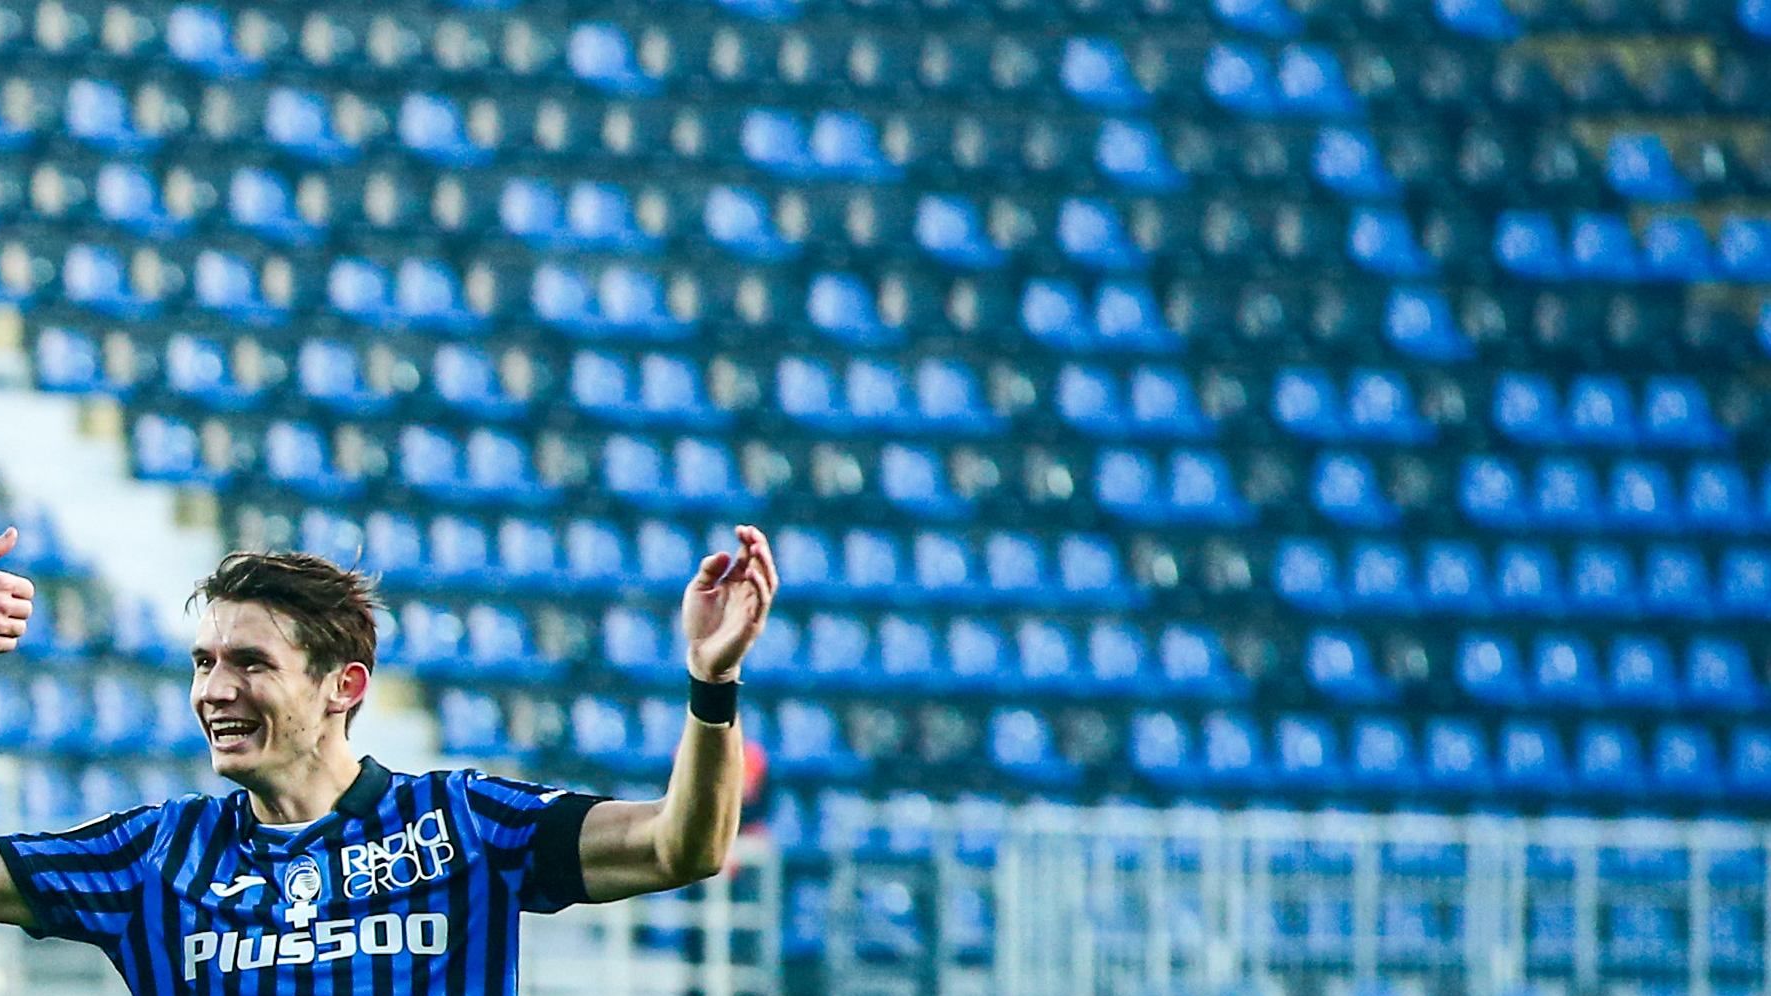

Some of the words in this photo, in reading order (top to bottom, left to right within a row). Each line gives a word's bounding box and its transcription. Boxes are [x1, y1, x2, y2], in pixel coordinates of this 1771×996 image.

[341, 808, 450, 876] RADICI
[342, 841, 455, 899] GROUP
[184, 912, 449, 982] Plus500
